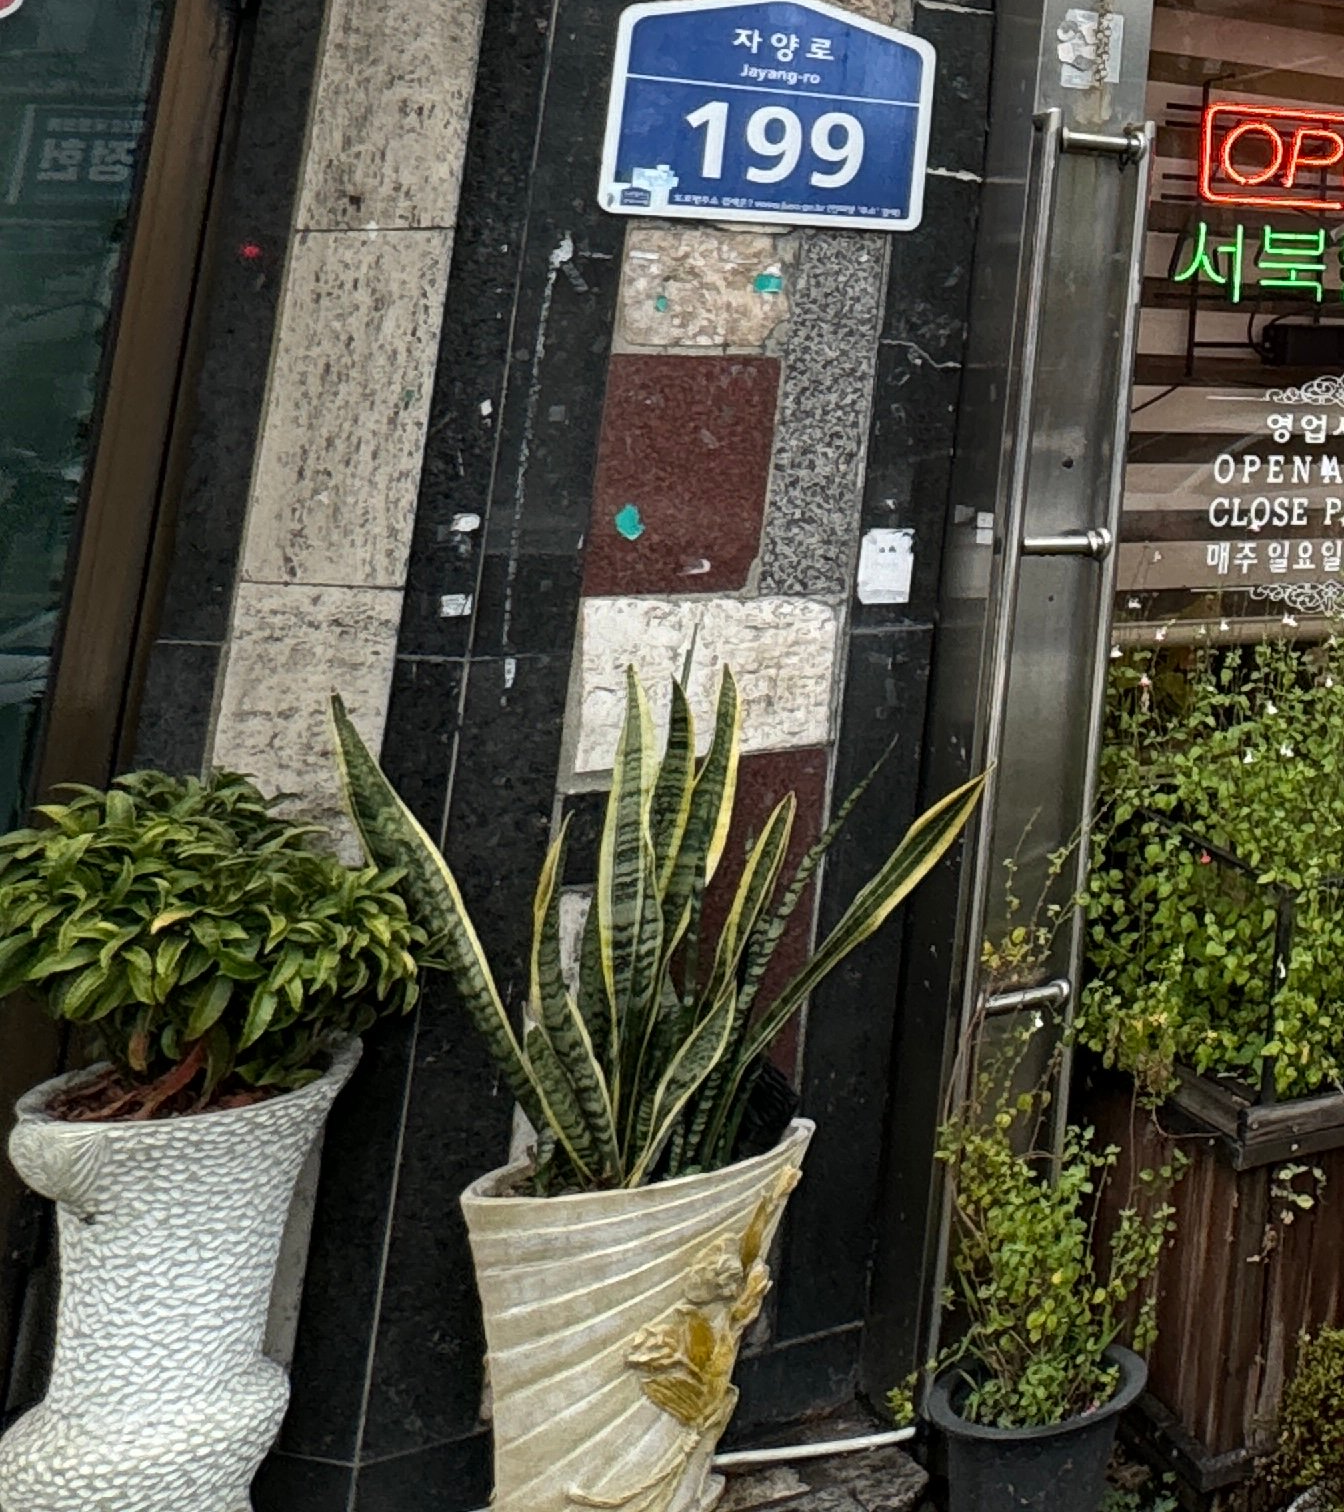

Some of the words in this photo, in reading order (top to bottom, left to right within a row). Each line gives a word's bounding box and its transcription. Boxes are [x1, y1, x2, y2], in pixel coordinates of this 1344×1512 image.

[732, 27, 835, 62] 자양로
[740, 64, 821, 86] Jayang-ro
[684, 99, 865, 189] 199
[1212, 455, 1310, 485] OPEN
[1208, 497, 1309, 529] CLOSE
[1205, 542, 1260, 574] 매주
